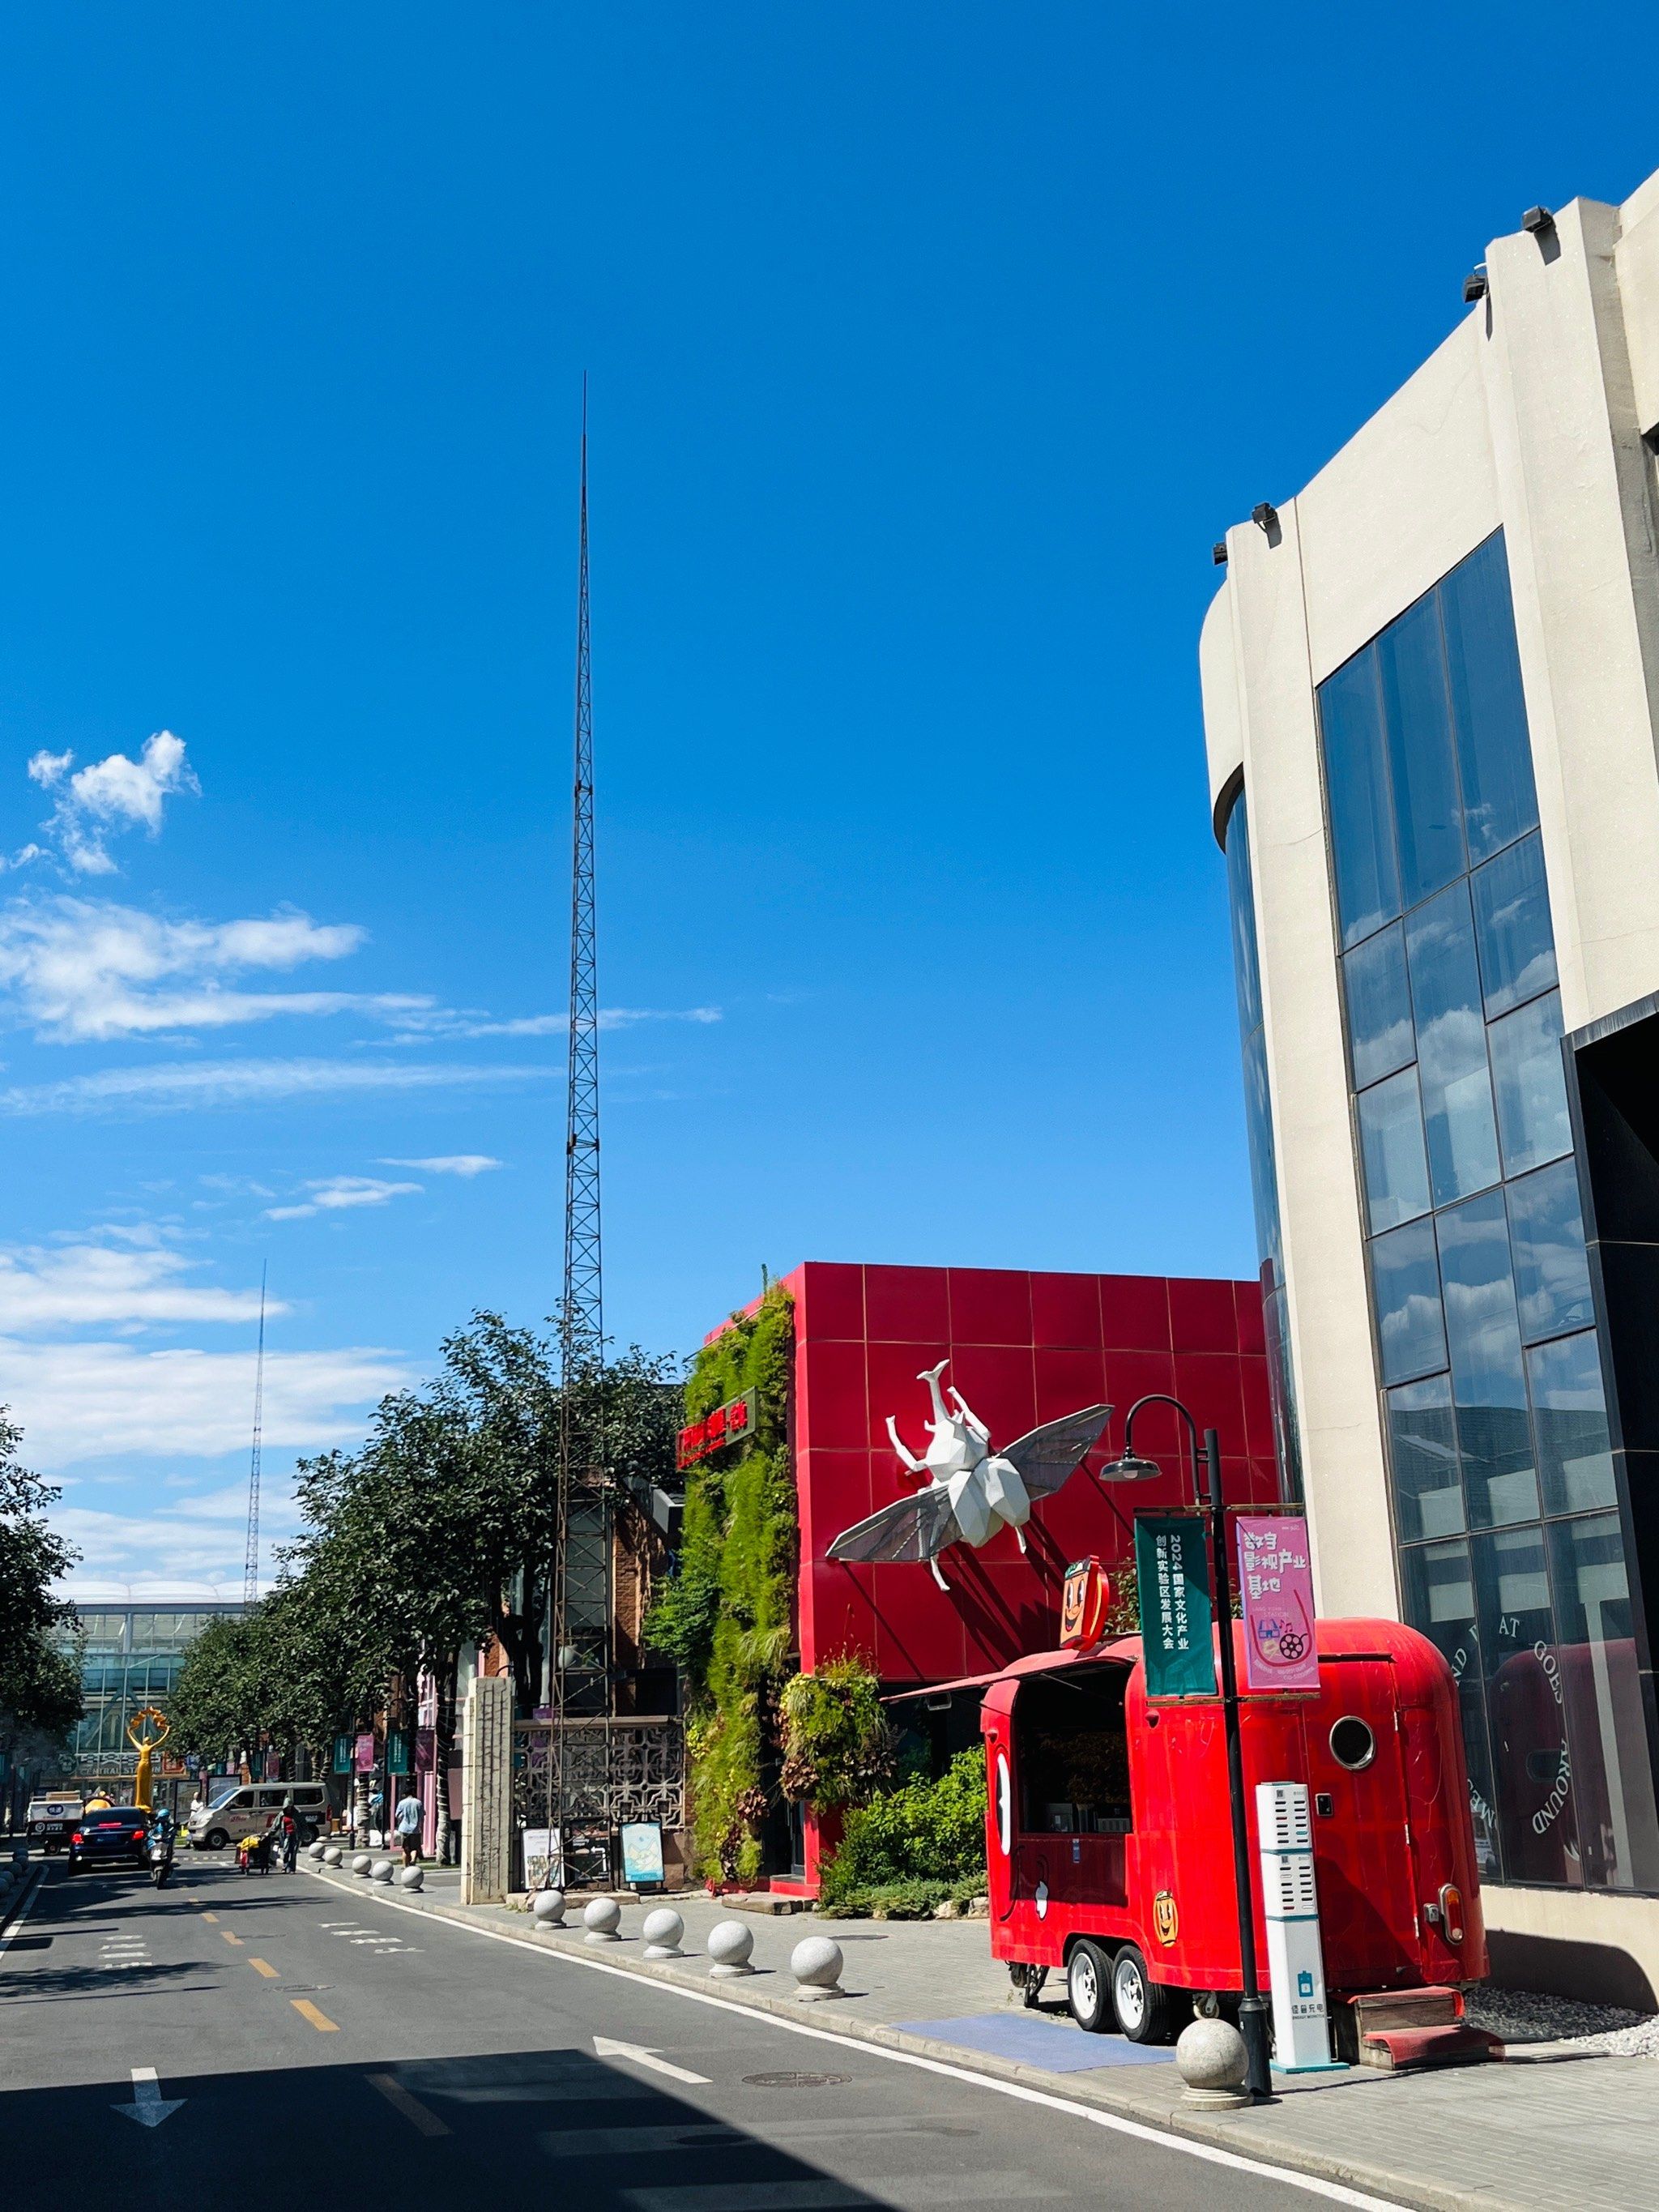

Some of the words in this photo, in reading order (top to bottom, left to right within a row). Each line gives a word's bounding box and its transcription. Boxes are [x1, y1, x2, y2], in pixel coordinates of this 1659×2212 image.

[1243, 1531, 1277, 1551] 数字
[1243, 1548, 1307, 1574] 影视产业
[1155, 1534, 1175, 1650] 创新实验区发展大会
[1170, 1534, 1189, 1650] 2024国家文化产业
[1247, 1574, 1282, 1600] 基地
